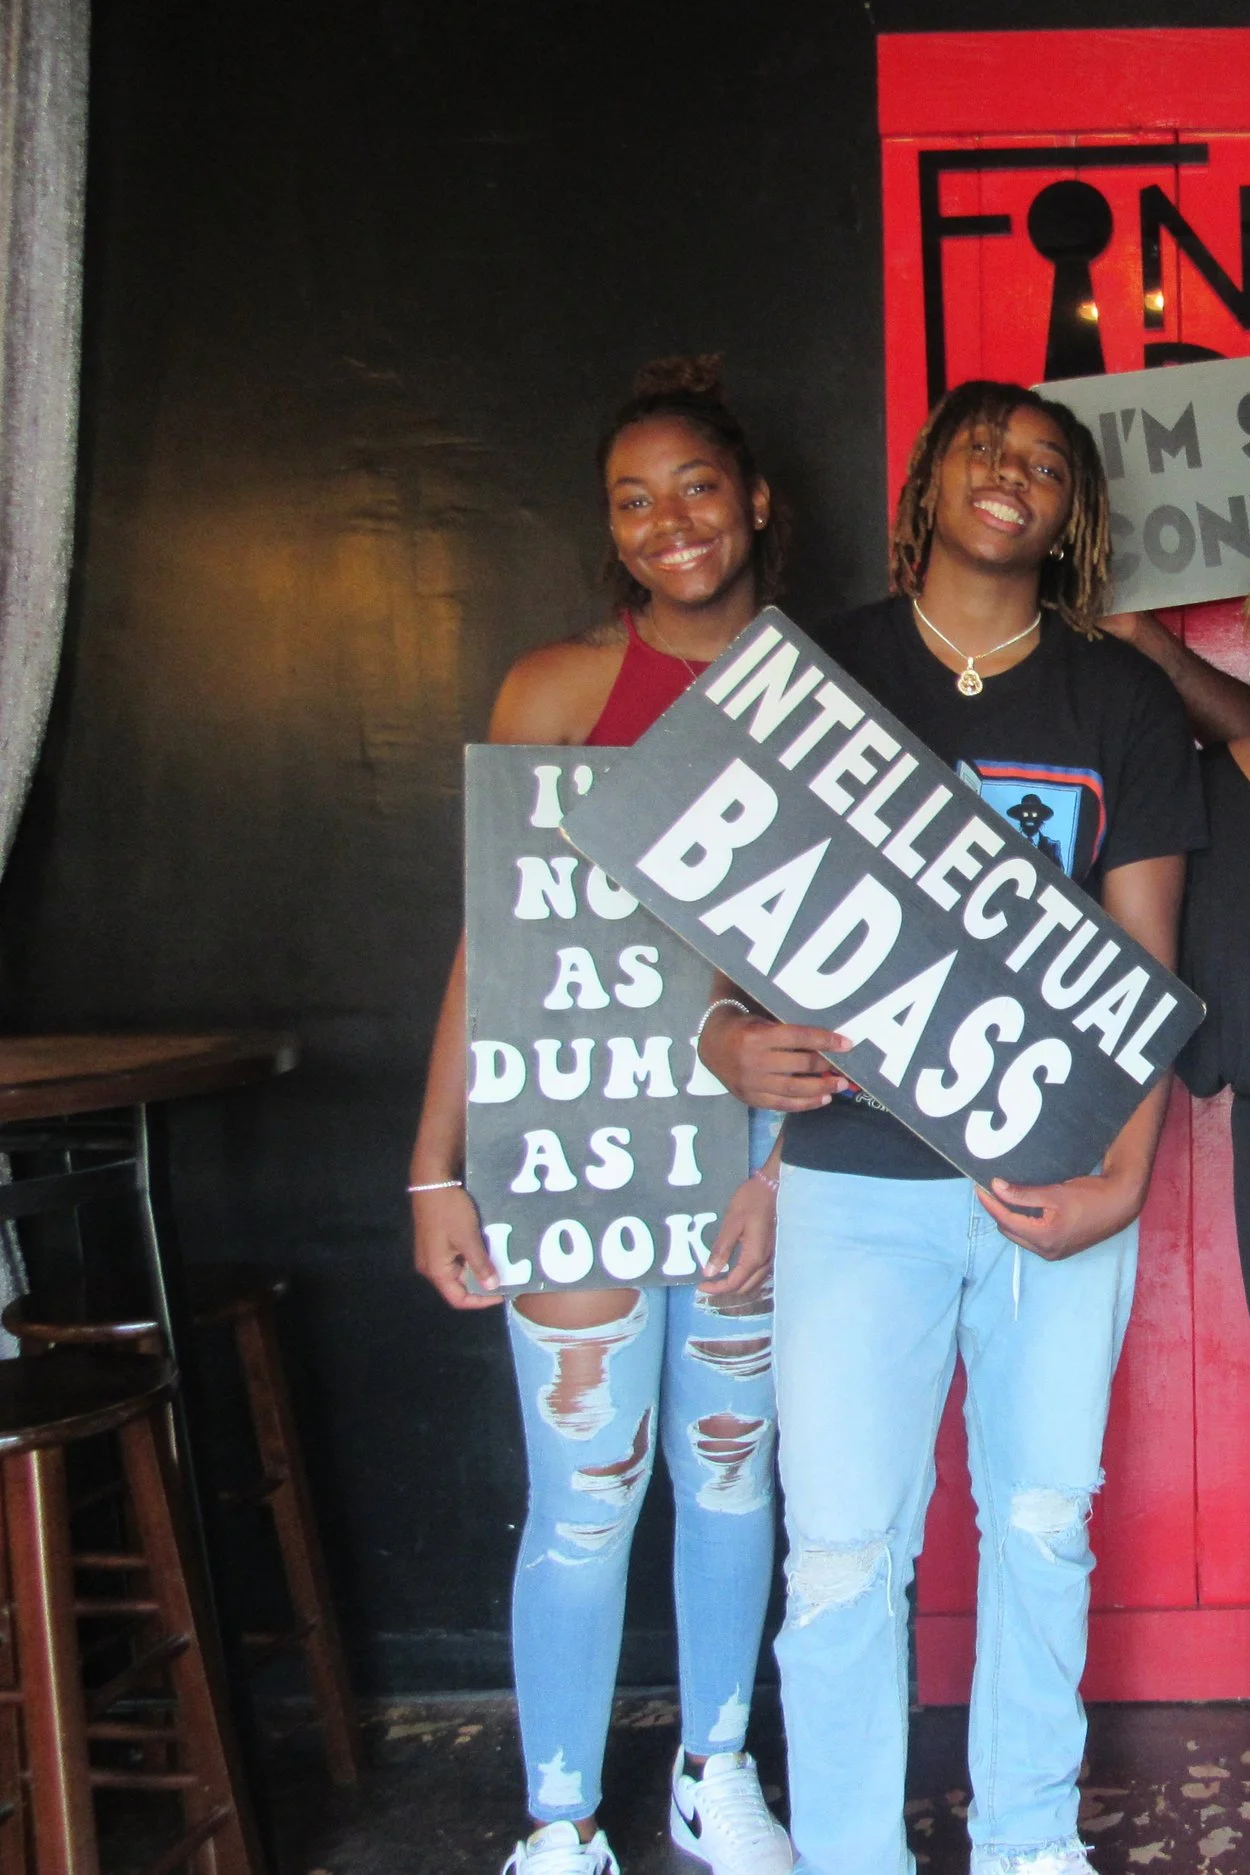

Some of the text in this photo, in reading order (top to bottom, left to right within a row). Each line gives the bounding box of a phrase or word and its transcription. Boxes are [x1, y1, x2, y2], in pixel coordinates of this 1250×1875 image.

[1099, 401, 1202, 481] I'M
[704, 625, 1178, 1085] INTELLECTUAL
[543, 945, 664, 1010] AS
[635, 757, 1073, 1160] BADASS
[510, 1124, 702, 1194] AS I
[485, 1212, 730, 1287] LOOK
